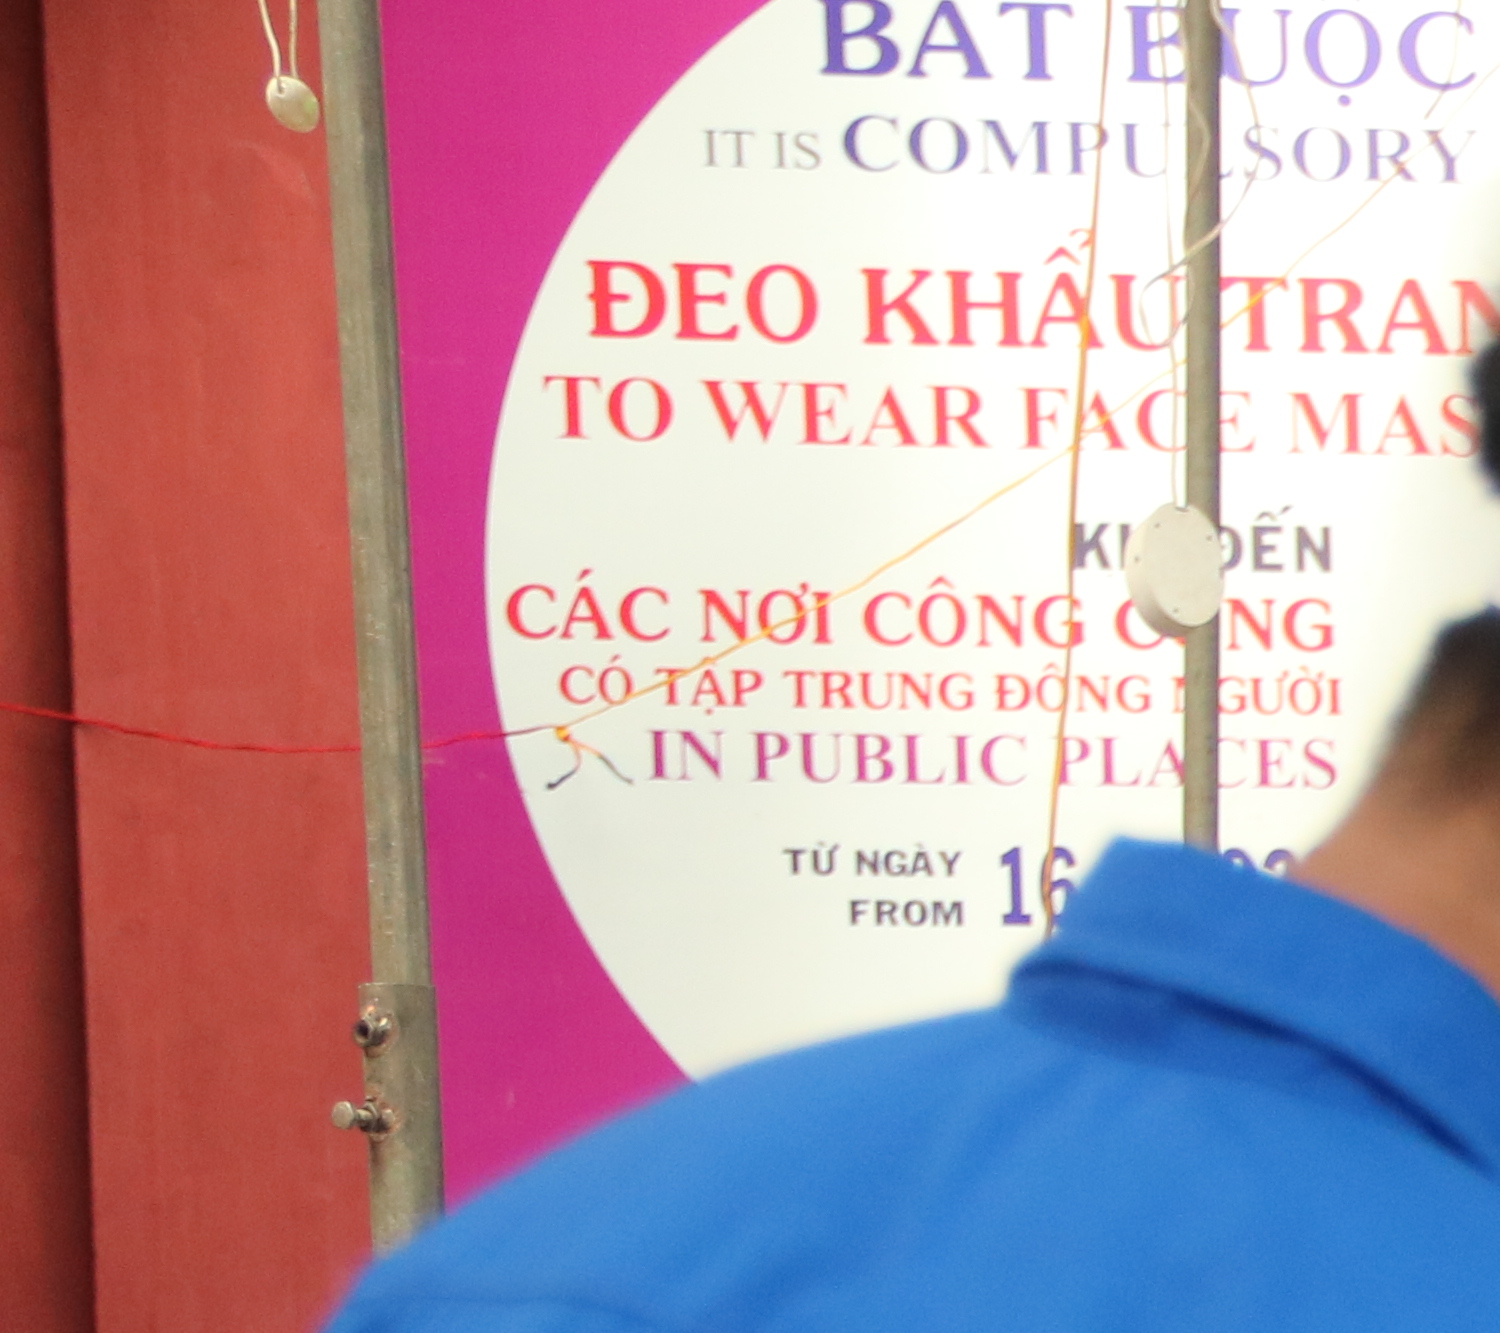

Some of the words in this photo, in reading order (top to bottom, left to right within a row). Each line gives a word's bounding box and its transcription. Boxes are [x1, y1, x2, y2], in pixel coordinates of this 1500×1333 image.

[701, 129, 756, 169] IT
[773, 131, 822, 171] IS
[843, 114, 1478, 185] COMPUSORY
[586, 258, 819, 345] ĐEO
[860, 227, 1190, 352] KHẨU
[543, 374, 673, 442] TO
[701, 379, 990, 449] WEAR
[1018, 386, 1257, 454] FACE
[1288, 392, 1482, 458] MAS
[504, 568, 672, 642] CÁC
[698, 582, 834, 645] NƠI
[862, 575, 1085, 649] CÔNG
[1114, 597, 1335, 653] CNG
[558, 653, 634, 705] CÓ
[783, 670, 975, 711] TRUNG
[647, 729, 727, 782] IN
[751, 731, 1028, 787] PUBLIC
[1058, 735, 1338, 790] PLACES
[782, 841, 840, 876] TỪ
[854, 843, 963, 877] NGÀY
[849, 898, 965, 927] FROM
